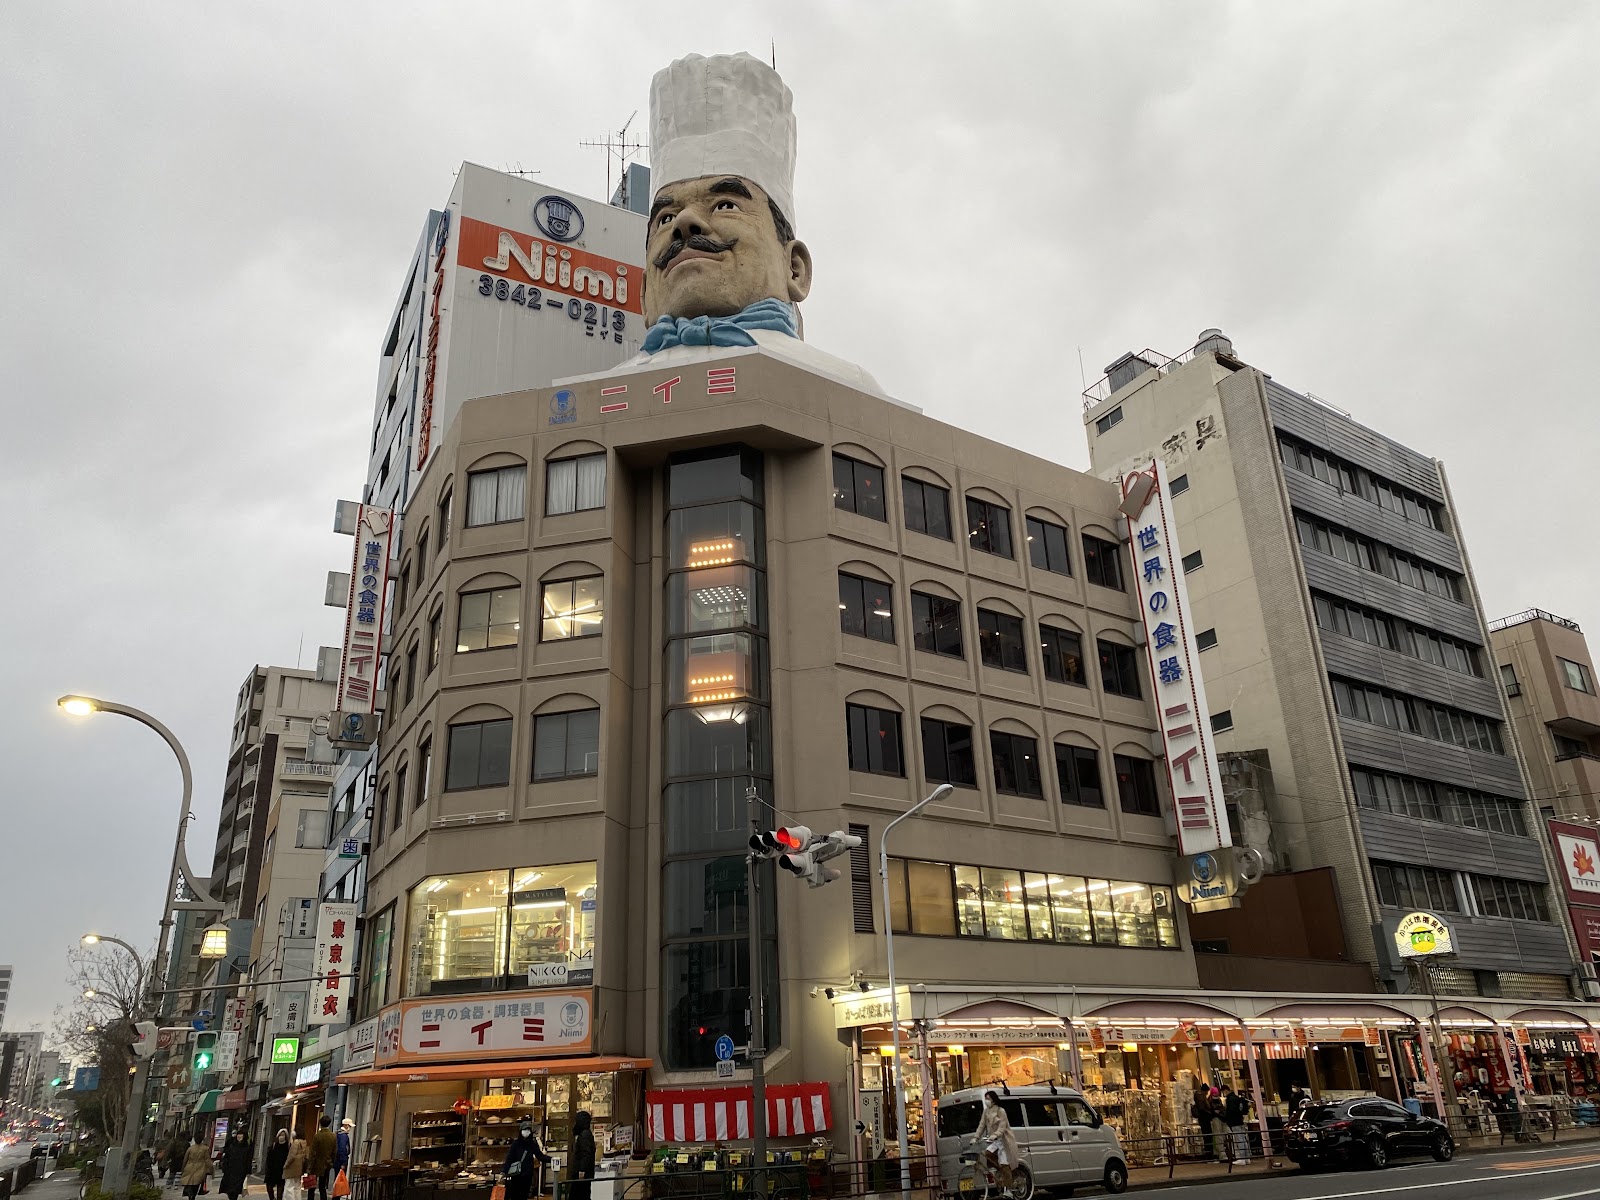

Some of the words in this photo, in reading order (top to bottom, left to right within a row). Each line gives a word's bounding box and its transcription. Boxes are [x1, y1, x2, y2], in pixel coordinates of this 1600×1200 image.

[483, 231, 628, 305] Niimi
[478, 274, 626, 332] 3842-0213
[585, 325, 623, 344] ニイミ
[600, 367, 736, 413] ニイミ
[356, 541, 382, 625] 世界の食器
[346, 630, 375, 700] ニイミ
[1137, 524, 1185, 685] 世界の食器
[1165, 702, 1212, 829] ニイミ
[343, 839, 359, 854] 歯
[1190, 881, 1227, 900] Niimi
[530, 965, 567, 977] NIKKO
[286, 1002, 298, 1031] 皮膚科
[421, 1002, 545, 1022] 世界の食器・調理器具
[419, 1018, 545, 1048] ニイミ
[558, 1028, 583, 1038] Niimi
[719, 1043, 727, 1058] P
